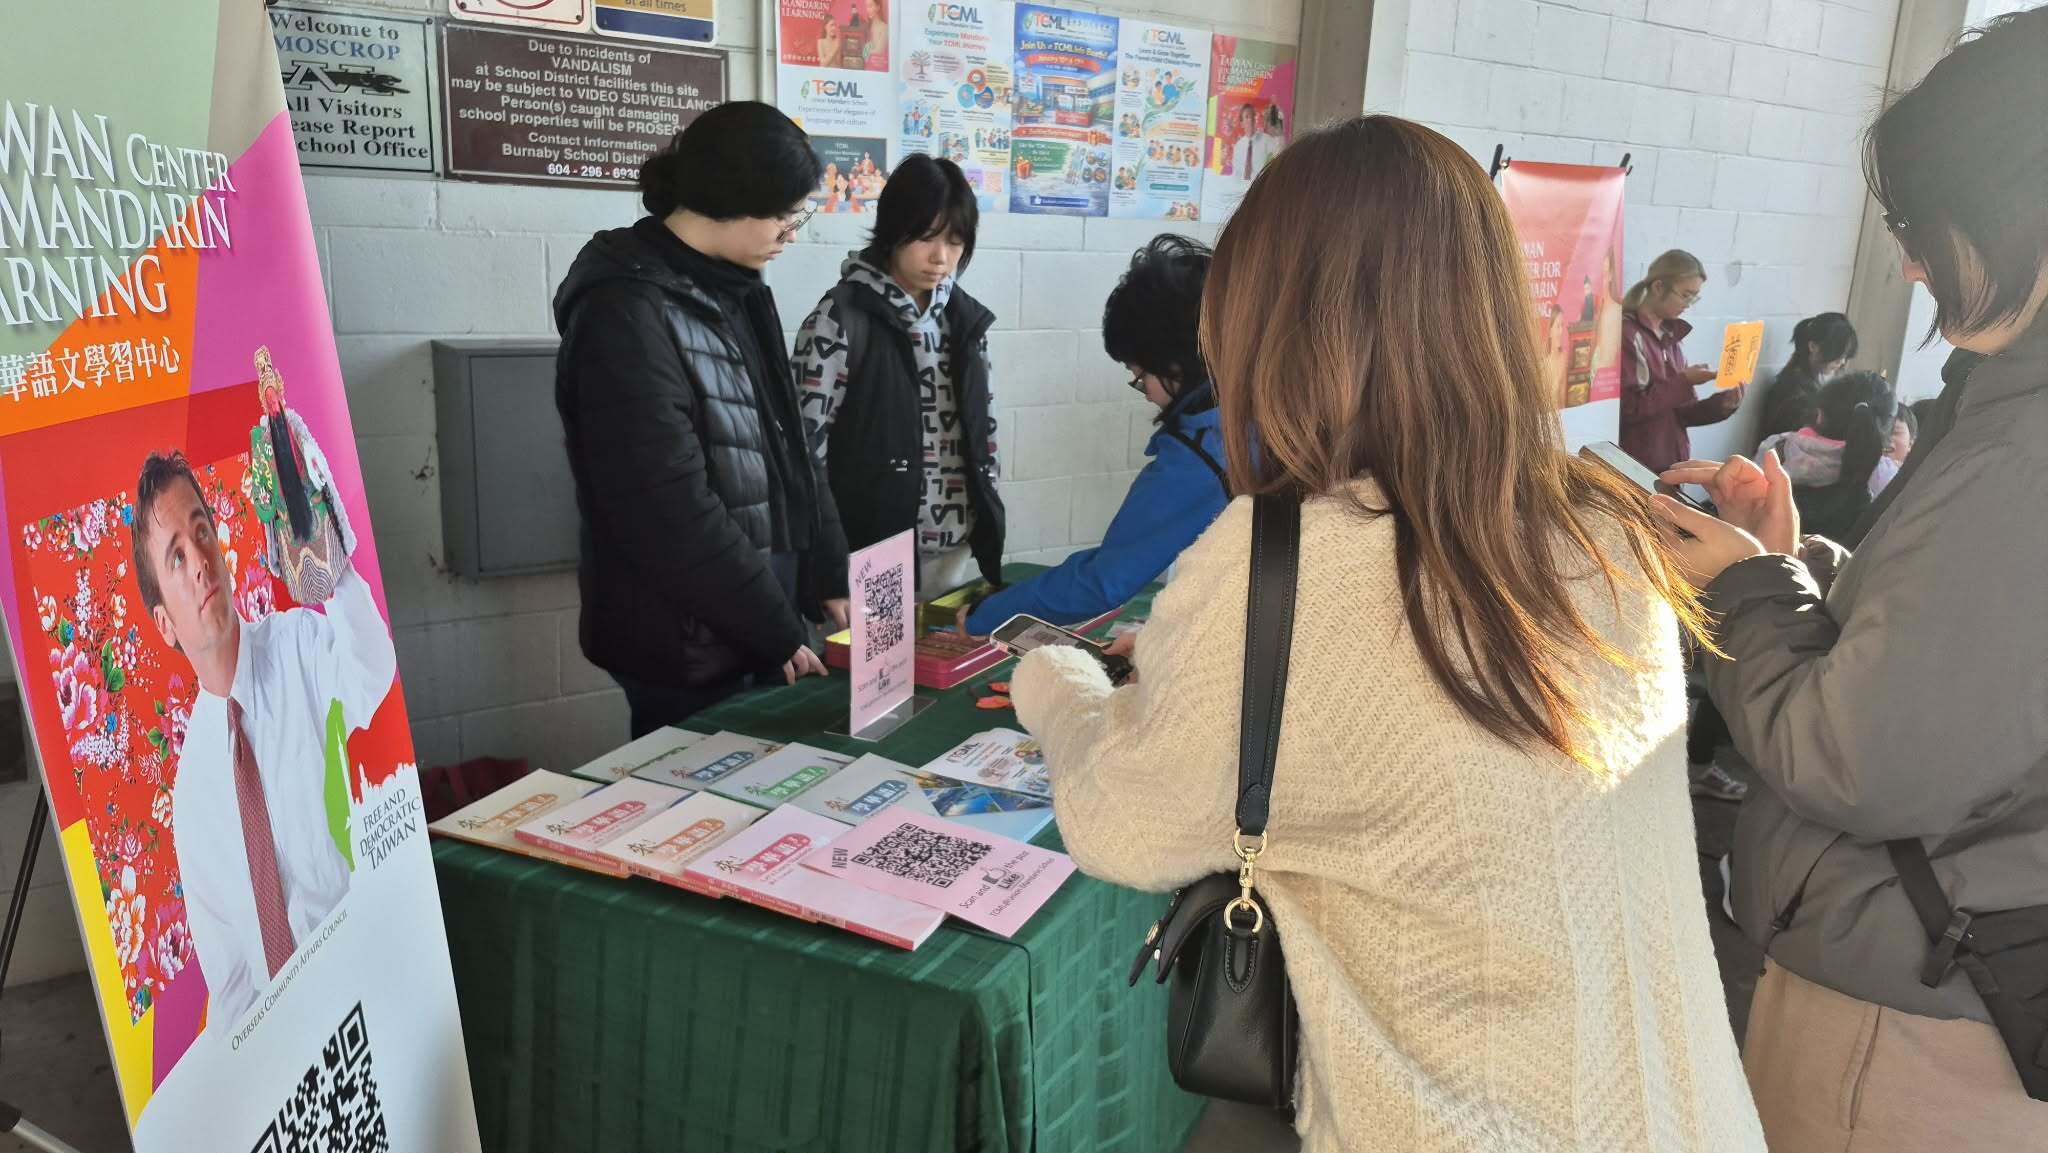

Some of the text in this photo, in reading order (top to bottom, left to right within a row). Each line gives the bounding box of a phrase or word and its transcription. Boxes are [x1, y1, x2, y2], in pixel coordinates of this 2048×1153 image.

[640, 0, 652, 8] all
[656, 0, 688, 12] times
[781, 8, 825, 20] LEARNING
[938, 3, 983, 24] TCML
[269, 11, 399, 41] Welcome to
[1151, 29, 1184, 45] TCML
[274, 35, 400, 60] MOSCROP
[528, 39, 652, 64] Due to incidents of
[552, 56, 632, 76] VANDALISM
[451, 78, 481, 92] may
[485, 79, 502, 91] be
[506, 82, 556, 98] subject
[559, 87, 573, 98] to
[577, 88, 618, 103] VIDEO
[475, 63, 699, 97] at School District facilities this site
[811, 79, 864, 98] TCML
[318, 97, 403, 119] Visitors
[501, 95, 680, 125] Person(s) caught damaging
[342, 118, 416, 139] Report
[459, 107, 686, 136] school properties will be PROSEC
[363, 139, 429, 159] Office
[502, 143, 651, 165] Burnaby School Distri
[528, 131, 657, 152] Contact Information
[126, 132, 236, 193] CENTER
[548, 163, 570, 176] 604
[581, 166, 603, 178] 296
[0, 170, 231, 249] MANDARIN
[1543, 261, 1561, 278] FOR
[0, 335, 180, 402] 華語文學習中心
[855, 558, 872, 589] NEW
[363, 788, 406, 833] FREE AND
[360, 798, 421, 857] DEMOCRATIC
[368, 817, 416, 870] TAIWAN
[832, 847, 849, 869] NEW
[997, 872, 1020, 890] Like
[959, 894, 977, 909] Scan
[976, 883, 991, 897] and
[231, 908, 348, 1051] OVERSEAS COMMUNITY AFFAIRS COUNCIL
